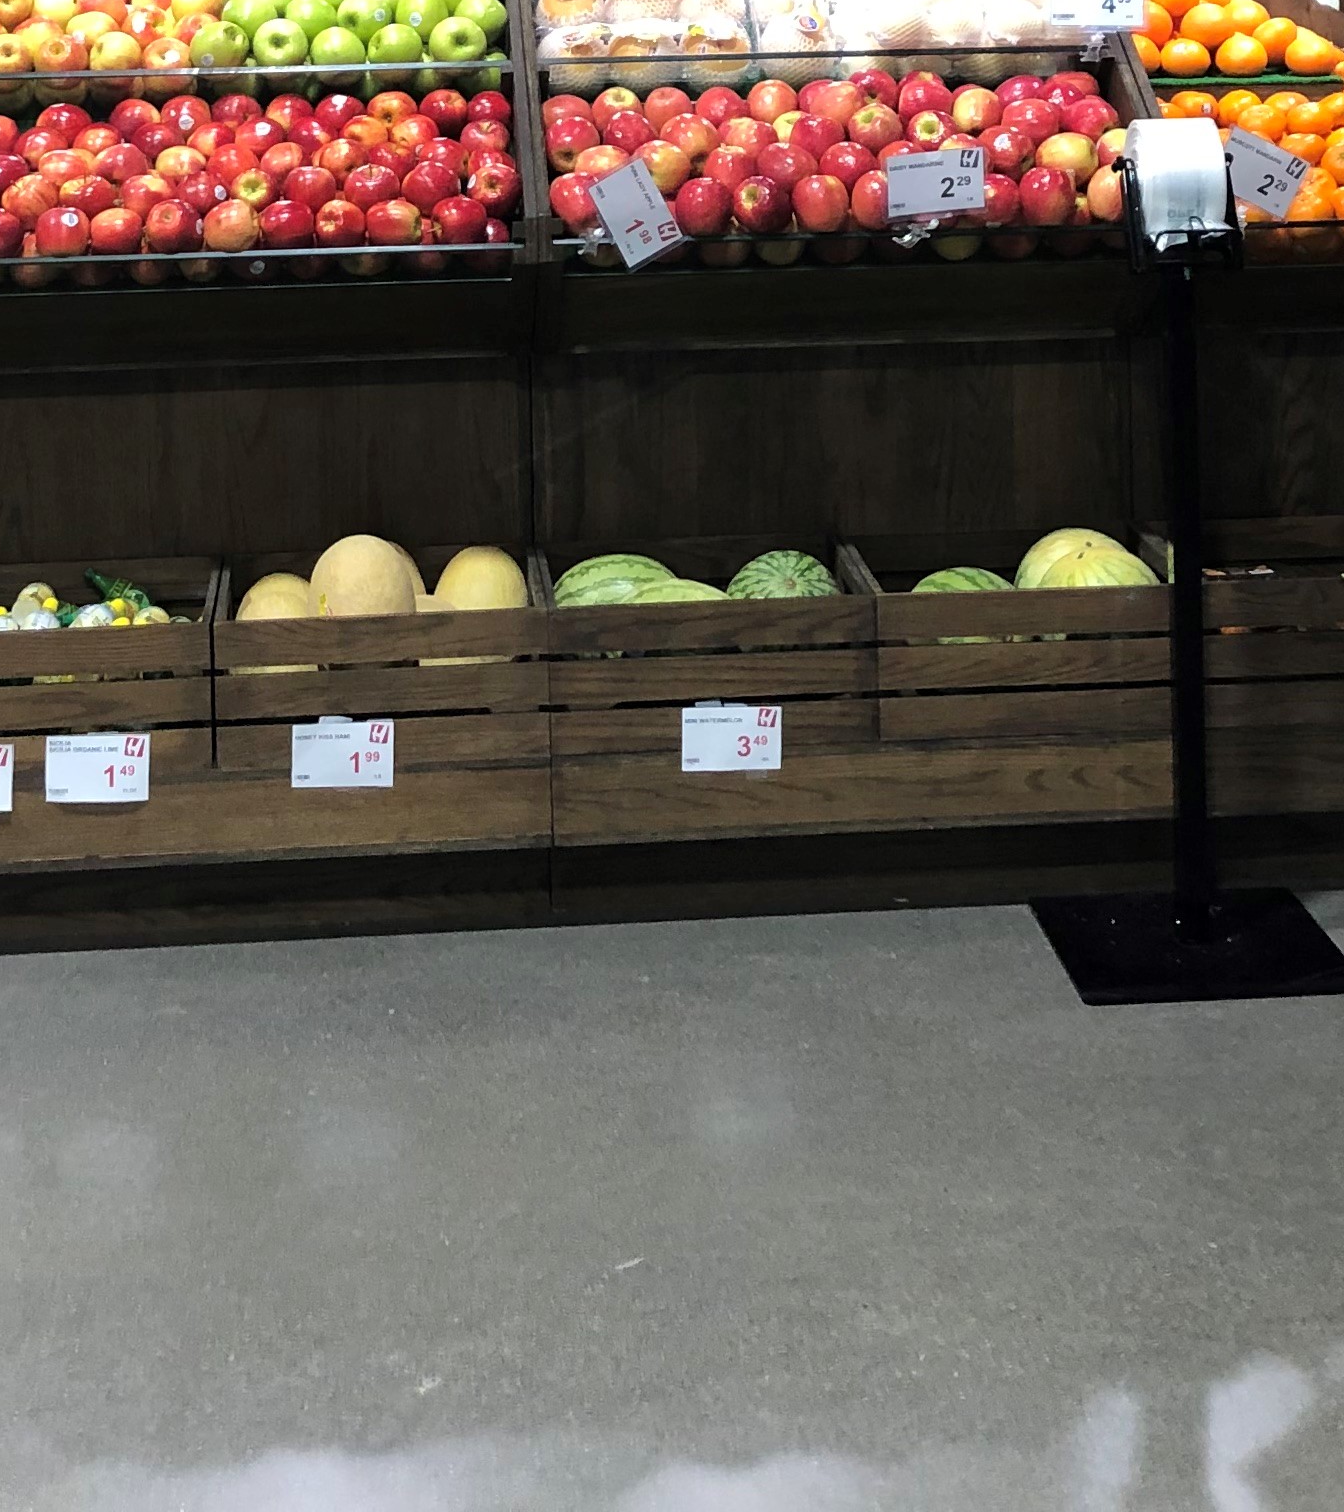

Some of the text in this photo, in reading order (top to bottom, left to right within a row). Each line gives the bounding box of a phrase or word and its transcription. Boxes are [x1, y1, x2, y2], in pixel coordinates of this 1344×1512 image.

[940, 175, 971, 198] 2 29
[1257, 174, 1288, 196] 2 29
[626, 219, 652, 244] 1 98
[737, 735, 768, 757] 3 49
[349, 751, 380, 773] 1 99
[104, 765, 135, 787] 1 49
